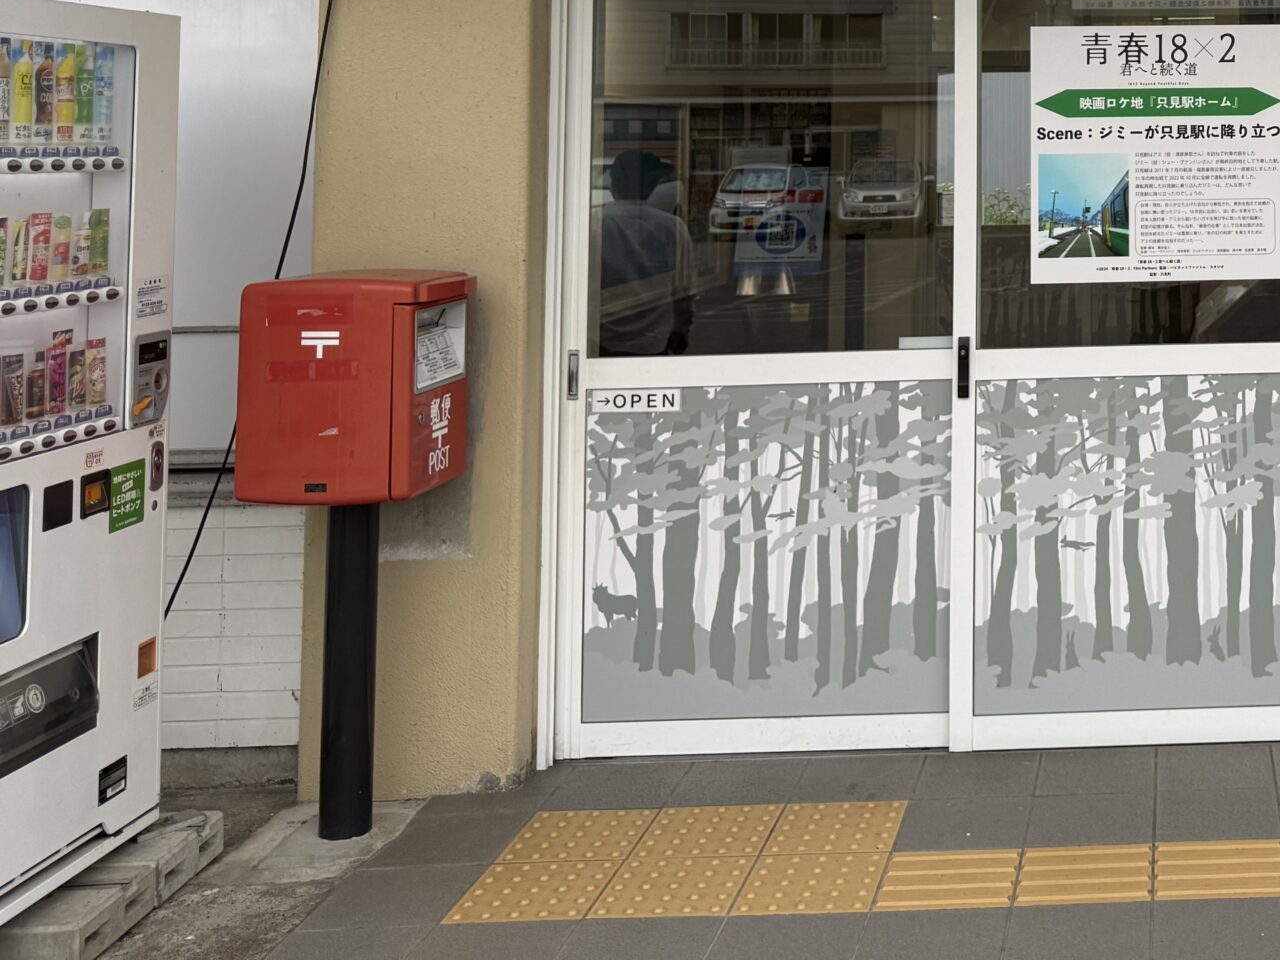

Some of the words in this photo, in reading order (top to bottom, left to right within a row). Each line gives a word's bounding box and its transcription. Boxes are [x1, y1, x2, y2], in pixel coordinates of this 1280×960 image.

[1080, 32, 1237, 65] 青春18×2
[1119, 62, 1198, 77] 君へと続く道
[430, 393, 452, 425] 郵便
[612, 393, 676, 409] OPEN
[429, 445, 451, 476] POST
